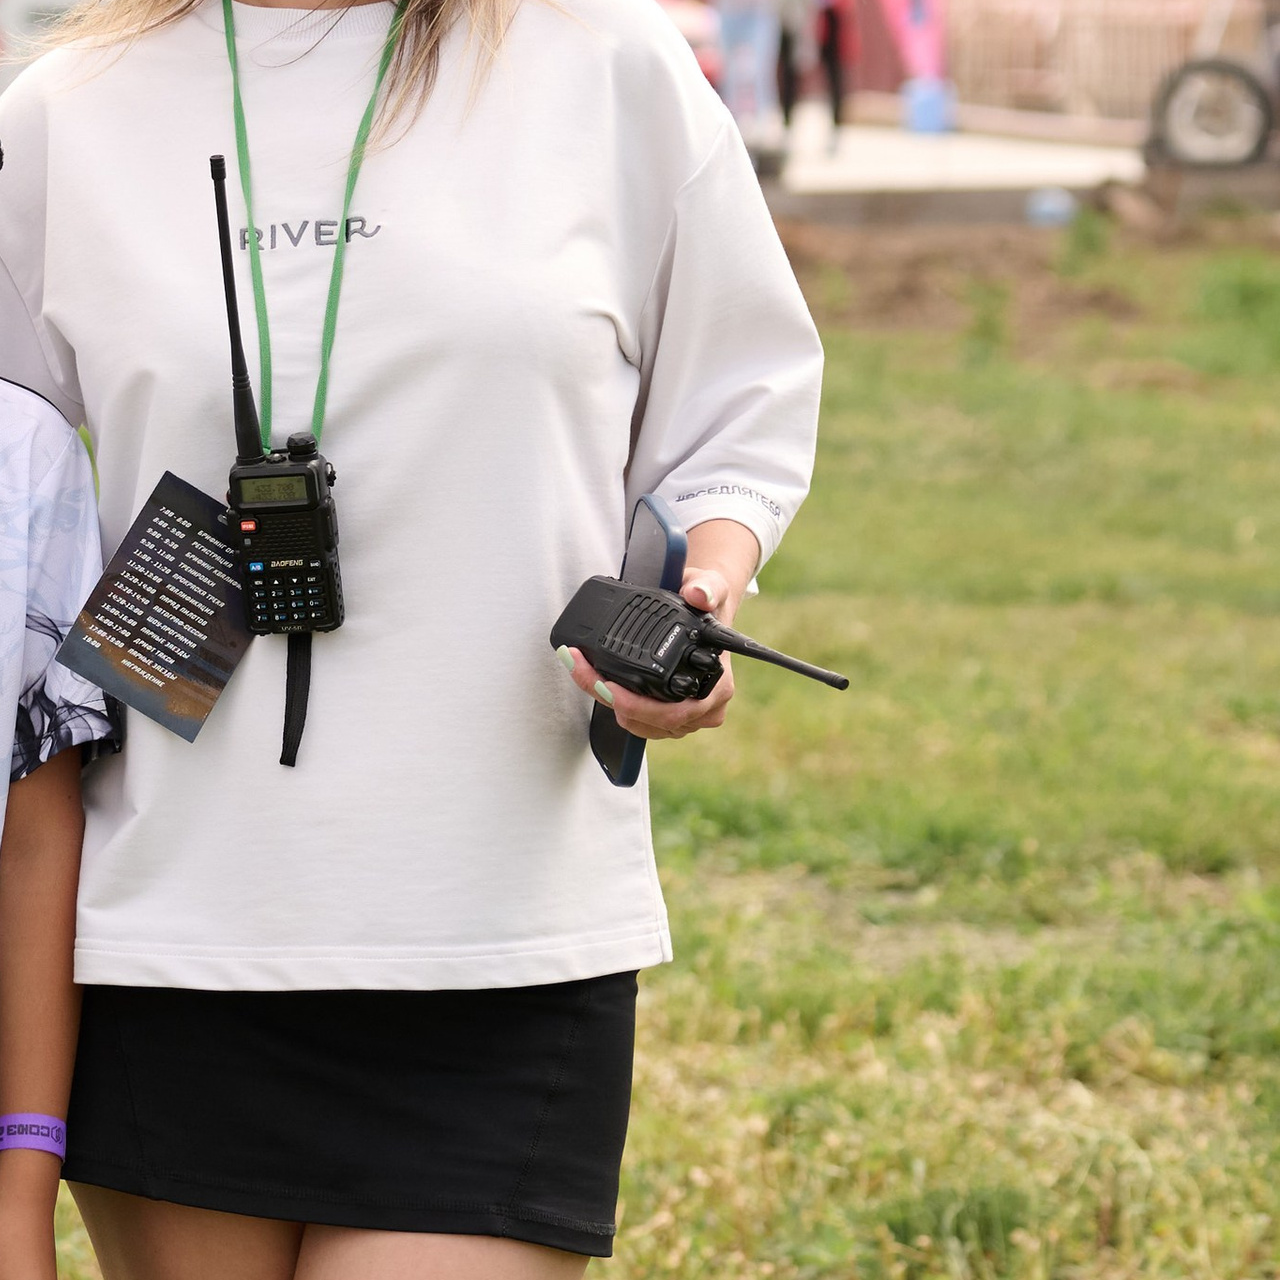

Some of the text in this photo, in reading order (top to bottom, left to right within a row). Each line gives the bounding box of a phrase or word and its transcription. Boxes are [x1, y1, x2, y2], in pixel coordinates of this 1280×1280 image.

[239, 216, 382, 251] RIVER
[191, 540, 233, 568] РЕГИСТРАЦИЯ
[197, 529, 226, 548] БРИФИНГ
[178, 561, 216, 587] ТРЕНИРОВКИ
[184, 551, 214, 570] БРИФИНГ
[270, 559, 303, 568] BAOFENG
[165, 583, 214, 615] КВАЛИФИКАЦИЯ
[171, 573, 207, 596] ПРОКРАСКА
[205, 593, 225, 607] ТРЕКА
[152, 605, 207, 640] АВТОГРАФ-СЕССИЯ
[158, 594, 180, 610] ПАРАД
[179, 606, 207, 626] ПИЛОТОВ
[140, 626, 166, 644] ПАРНЫЕ
[164, 641, 190, 658] ЗАЕЗДЫ
[146, 615, 196, 648] ШОУ-ПРОГРАММА
[127, 648, 153, 665] ПАРНЫЕ
[151, 662, 177, 680] ЗАЕЗДЫ
[132, 637, 156, 652] ДРИФТ
[154, 649, 175, 664] ТАКСИ
[120, 658, 165, 687] НАГРАЖДЕНИЕ
